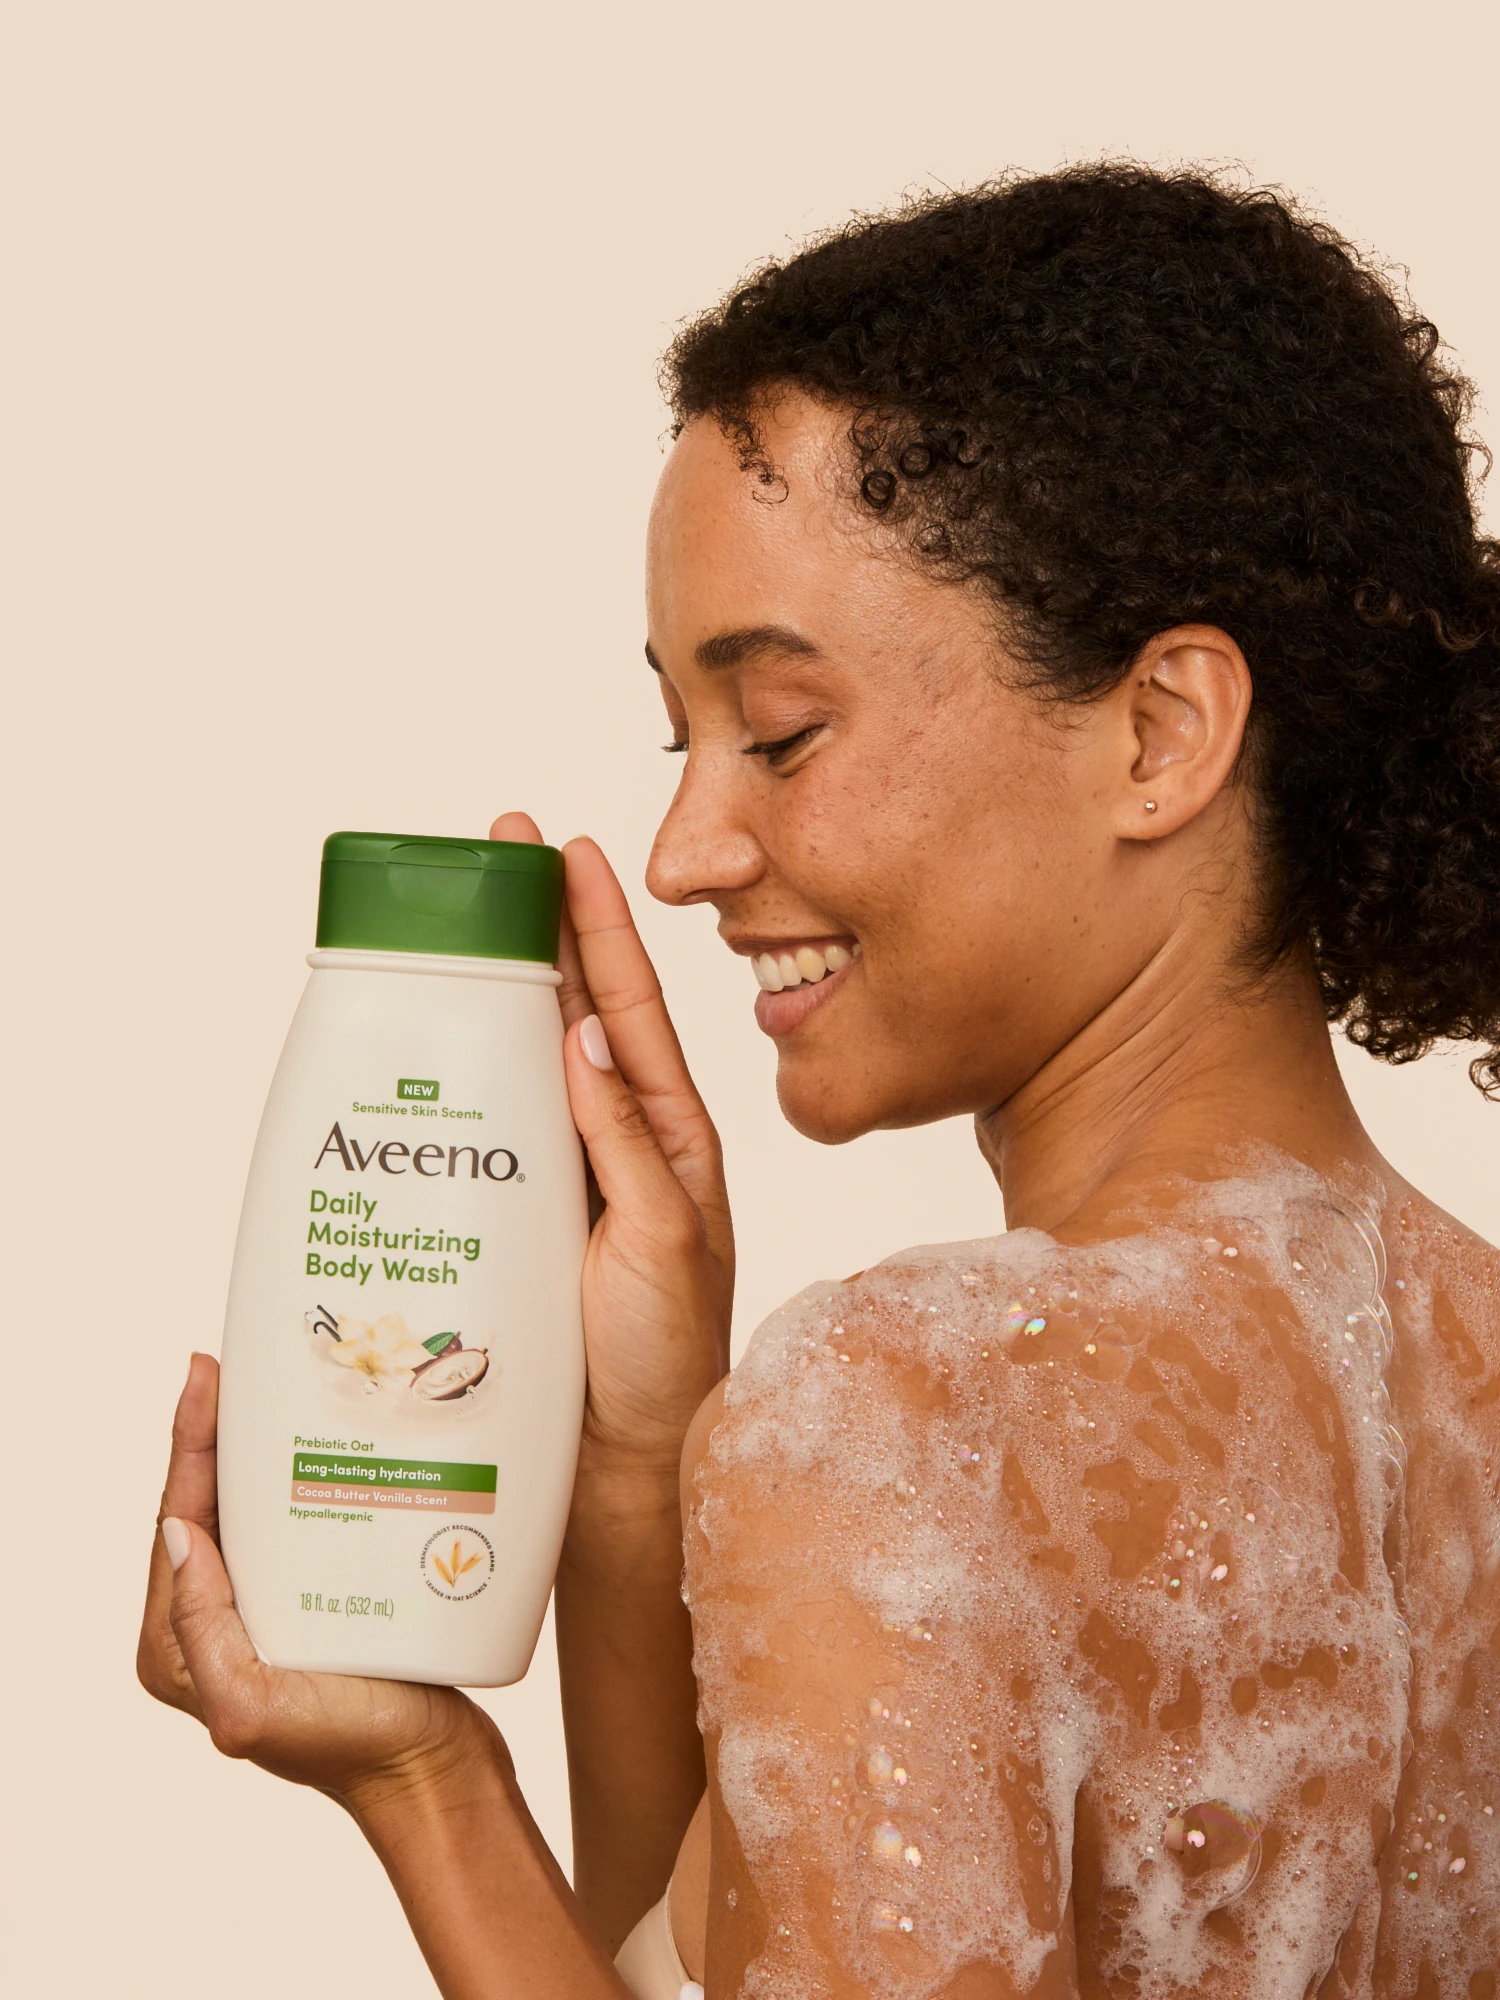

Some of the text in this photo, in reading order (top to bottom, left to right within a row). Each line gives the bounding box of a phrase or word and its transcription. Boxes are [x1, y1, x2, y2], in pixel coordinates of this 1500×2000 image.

[404, 1084, 434, 1097] NEW
[352, 1102, 483, 1120] Sensitive Skin Scents
[310, 1189, 378, 1222] Daily
[307, 1221, 480, 1261] Moisturizing
[306, 1253, 458, 1286] Body Wash
[294, 1436, 374, 1452] Prebiotic Oat
[298, 1461, 441, 1482] Long-lasting hydration
[297, 1486, 447, 1506] Cocoa Butter Vanilla Scent
[289, 1507, 373, 1523] Hypoallergenic
[420, 1526, 450, 1569] DERMATOLOGIST
[452, 1525, 492, 1550] RECOMMENDED
[425, 1580, 444, 1598] LEADER
[300, 1592, 394, 1620] 18 fl. oz. (532 mL)
